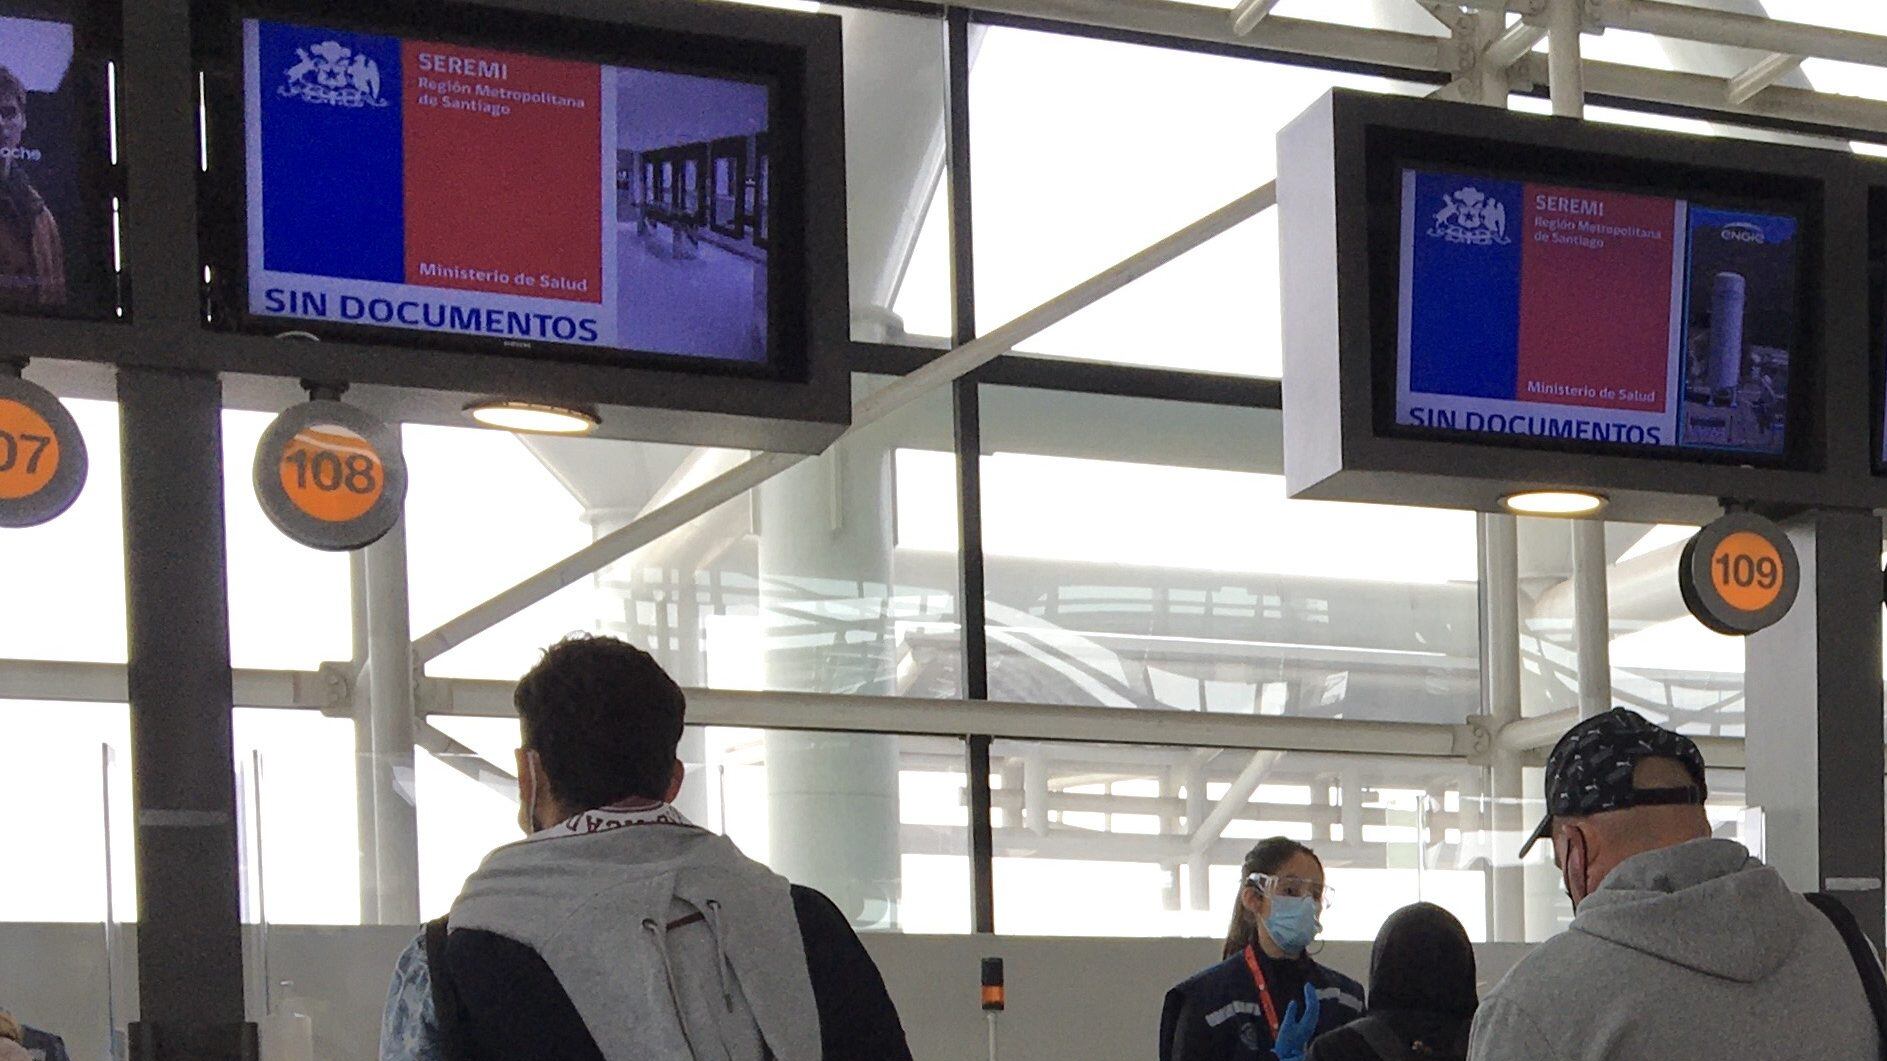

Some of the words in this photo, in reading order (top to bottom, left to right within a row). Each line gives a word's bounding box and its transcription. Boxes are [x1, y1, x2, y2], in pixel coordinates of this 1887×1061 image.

[418, 53, 508, 80] SEREMI
[417, 77, 471, 94] Región
[475, 84, 585, 108] Metropolitana
[418, 94, 438, 107] de
[442, 97, 511, 116] Santiago
[1536, 195, 1604, 216] SEREMI
[1534, 232, 1549, 242] de
[1553, 233, 1604, 249] Santiago
[1578, 220, 1662, 240] Metropolitana
[419, 262, 509, 284] Ministerio
[514, 271, 535, 286] de
[540, 274, 588, 292] Salud
[265, 288, 328, 317] SIN
[341, 294, 599, 342] DOCUMENTOS
[1527, 381, 1596, 398] Ministerio
[1599, 387, 1616, 399] de
[1619, 388, 1656, 402] Salud
[1409, 407, 1456, 429] SIN
[1466, 412, 1661, 445] DOCUMENTOS
[286, 448, 377, 494] 108
[1715, 553, 1778, 590] 109
